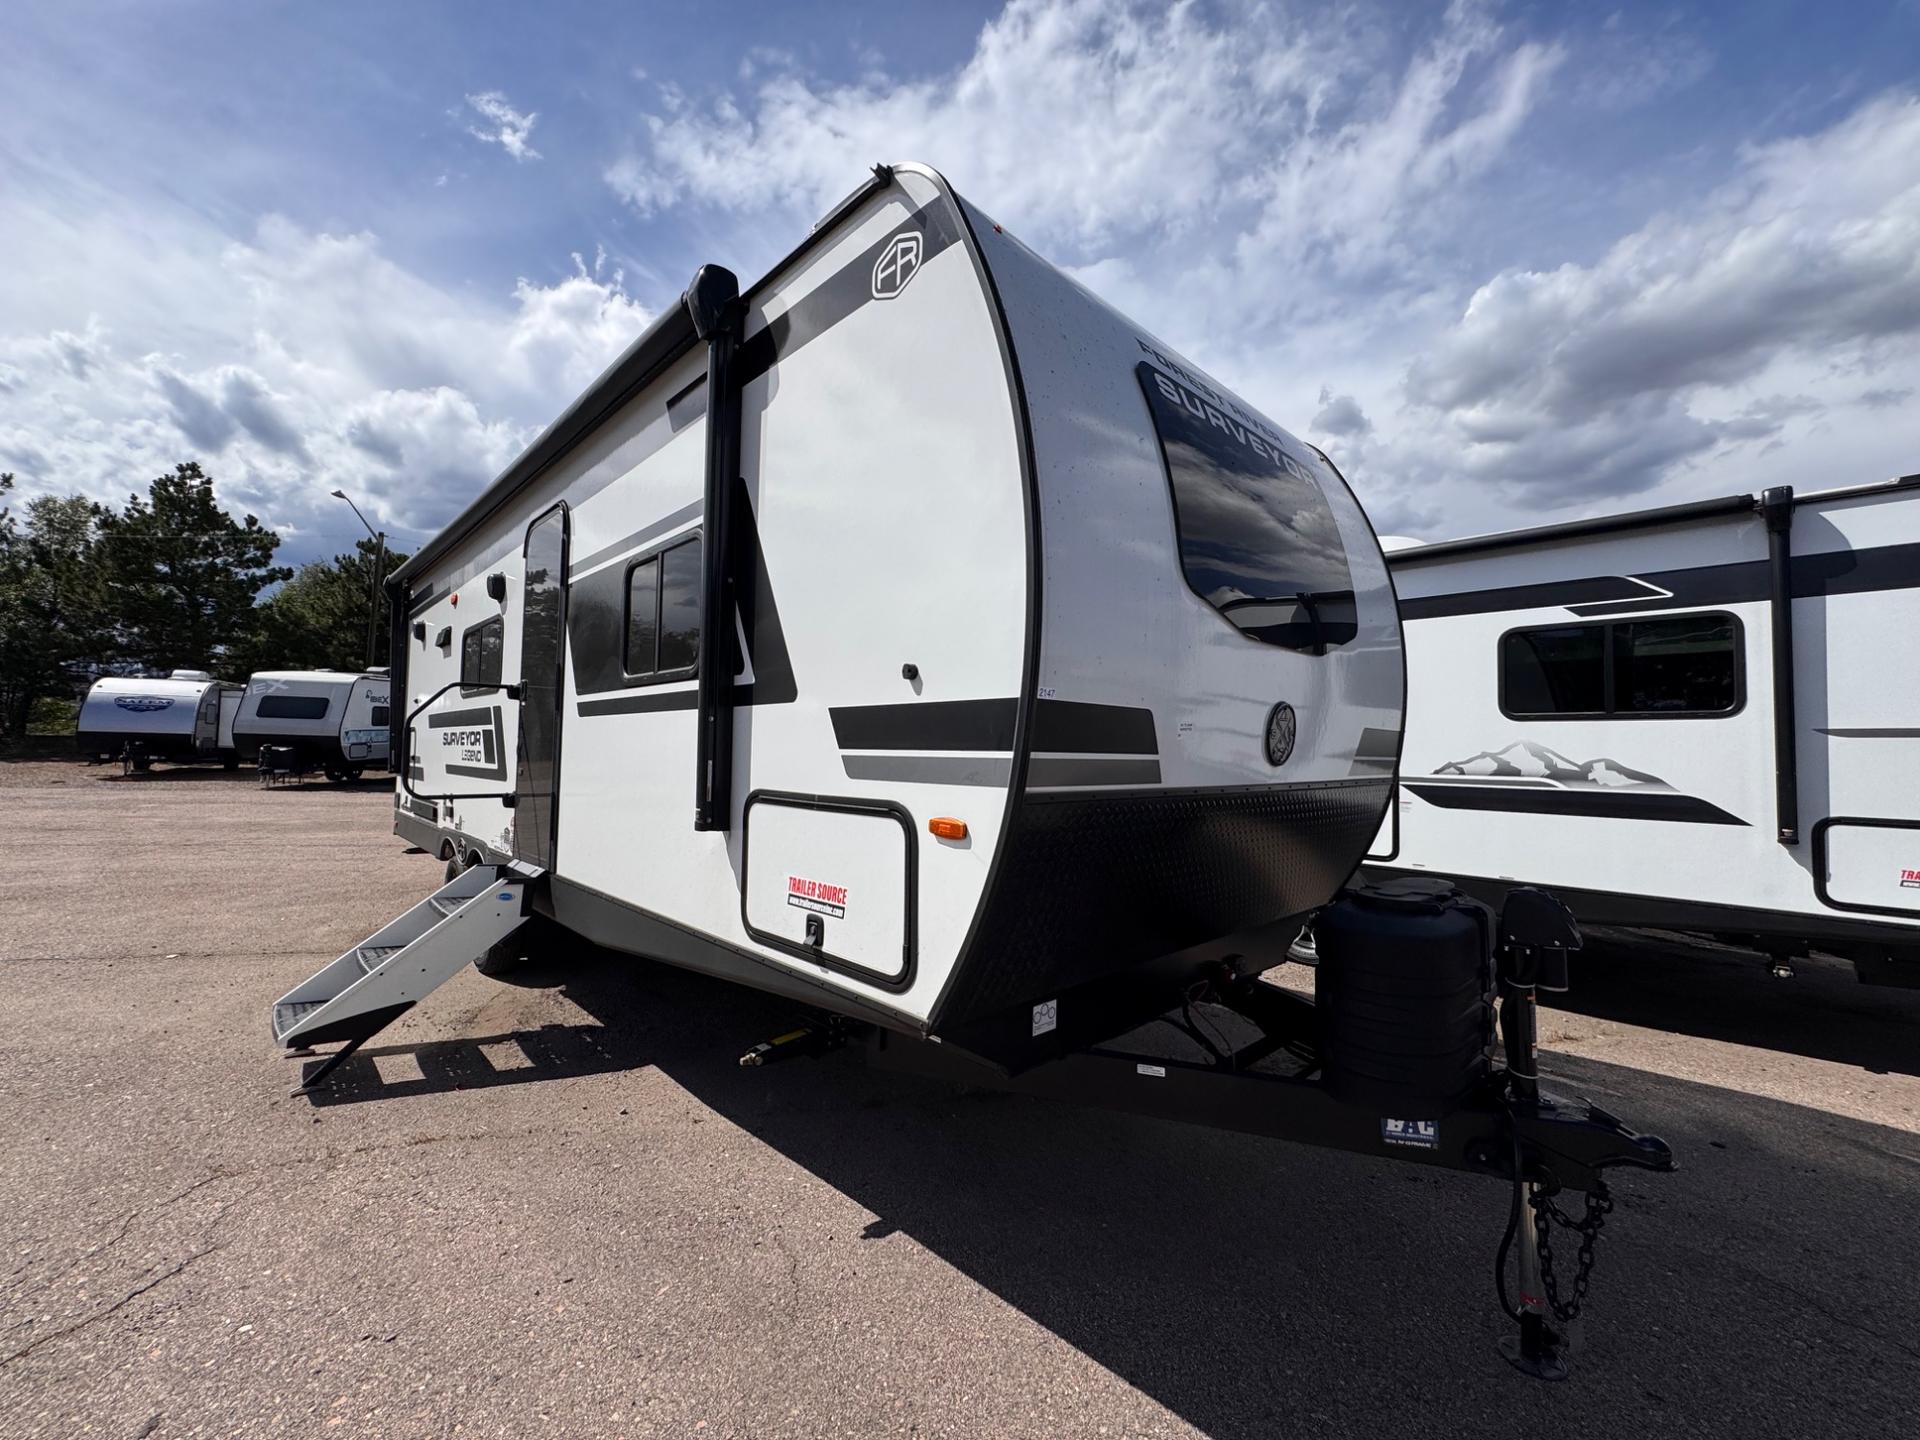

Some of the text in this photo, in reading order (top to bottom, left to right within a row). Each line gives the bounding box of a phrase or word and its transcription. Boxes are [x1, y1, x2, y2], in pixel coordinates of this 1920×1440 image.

[1135, 337, 1285, 447] FOREST RIVER
[1154, 373, 1318, 490] SURVEYOR
[442, 730, 481, 746] SURVEYOR
[461, 749, 482, 762] LEGEND
[788, 876, 848, 905] TRAILER SOURCE
